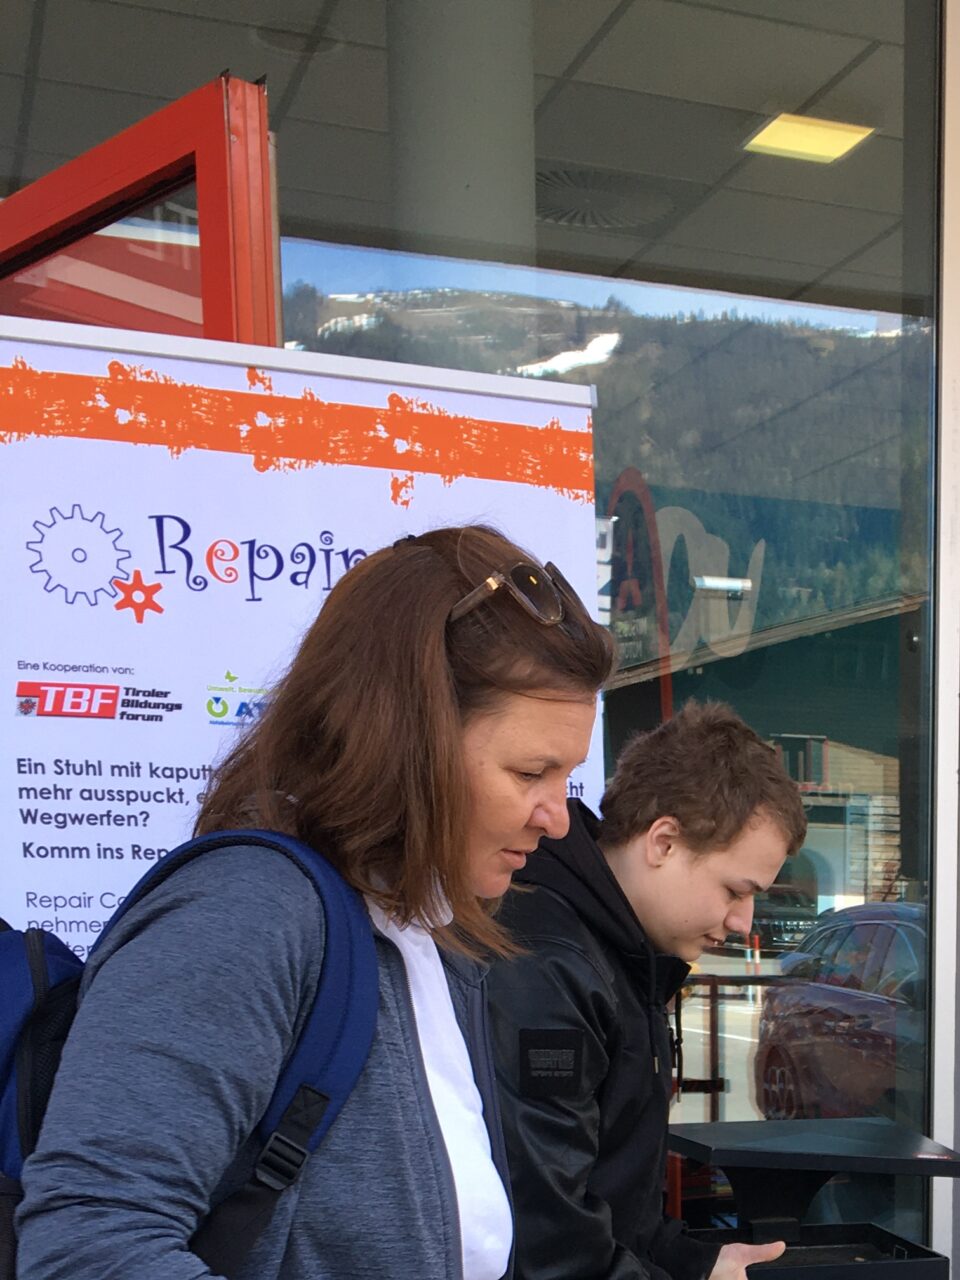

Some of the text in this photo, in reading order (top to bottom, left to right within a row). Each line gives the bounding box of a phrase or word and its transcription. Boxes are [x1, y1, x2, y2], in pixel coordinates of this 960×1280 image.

[17, 660, 135, 675] Eine Kooperation von:
[40, 685, 116, 715] TBF
[123, 687, 171, 699] Tiroler
[120, 698, 183, 711] Bildungs
[119, 711, 164, 722] forum
[17, 758, 46, 775] Ein
[53, 759, 103, 776] Stuhl
[110, 761, 142, 778] mit
[18, 784, 73, 800] mehr
[79, 787, 191, 806] ausspuckt,
[19, 808, 151, 828] Wegwerfen?
[22, 842, 91, 859] Komm
[97, 843, 125, 860] ins
[26, 892, 94, 911] Repair
